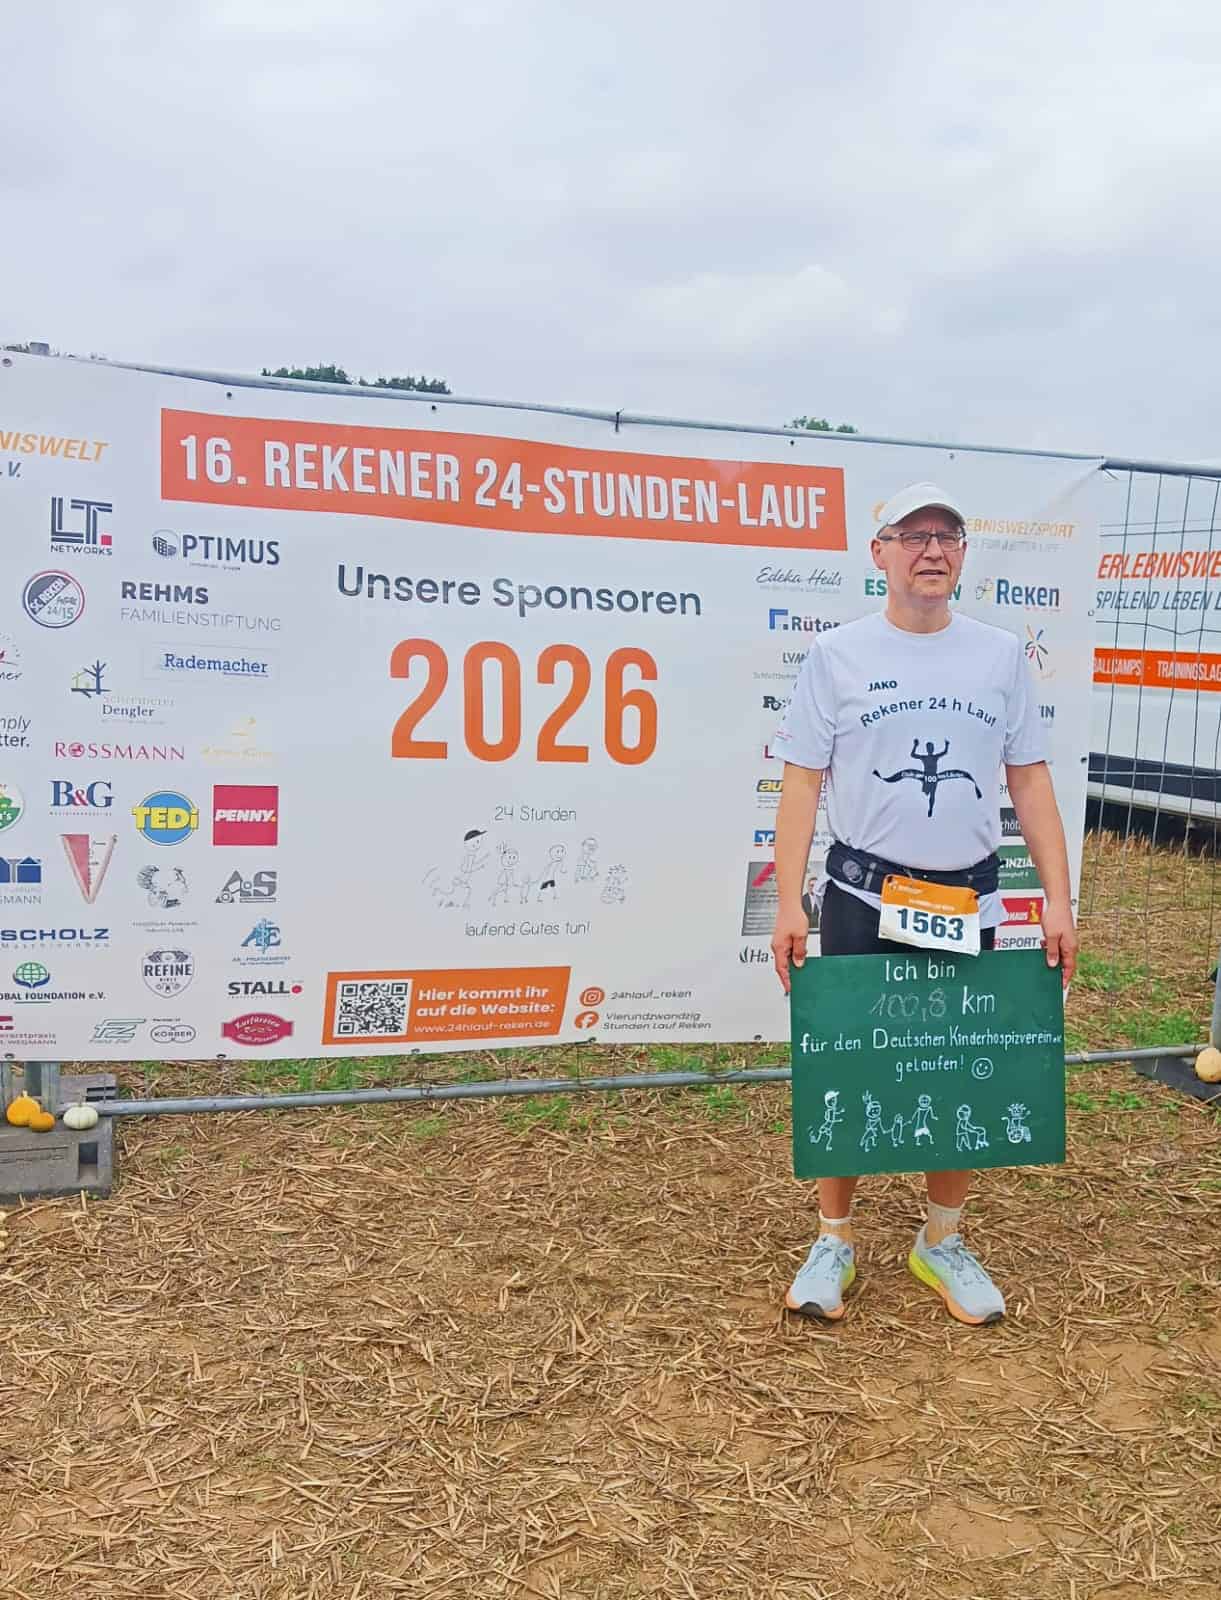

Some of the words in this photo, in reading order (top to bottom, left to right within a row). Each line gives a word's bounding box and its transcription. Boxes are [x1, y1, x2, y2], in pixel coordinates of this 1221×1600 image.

[180, 435, 247, 486] 16.
[265, 440, 460, 502] REKENER
[474, 456, 827, 530] 24-STUNDEN-LAUF
[51, 544, 112, 556] NETWORKS
[756, 566, 801, 584] Edeka
[807, 567, 843, 586] Heils
[122, 581, 209, 604] REHMS
[337, 563, 482, 606] Unsere
[492, 577, 703, 618] Sponsoren
[996, 578, 1060, 607] Reken
[121, 606, 281, 633] FAMILIENSTIFTUNG
[165, 653, 268, 673] Rademacher
[867, 680, 898, 692] JAKO
[103, 703, 155, 719] Dengler
[389, 637, 659, 766] 2026
[861, 699, 925, 727] Rekener
[929, 697, 947, 710] 24
[952, 698, 962, 711] h
[55, 741, 185, 761] ROSSMANN
[50, 780, 115, 808] B&G
[494, 805, 514, 821] 24
[519, 805, 577, 822] Stunden
[1, 928, 110, 941] SCHOLZ
[464, 920, 516, 938] laufend
[519, 920, 561, 937] Gutes
[896, 908, 965, 942] 1563
[144, 964, 193, 978] REFINE
[885, 959, 919, 982] Ich
[927, 956, 957, 980] bin
[25, 991, 85, 1001] FOUNDATION
[88, 991, 107, 1001] e.V.
[228, 981, 290, 996] STALL
[418, 987, 455, 1001] Hier
[458, 985, 521, 1001] kommt
[526, 984, 549, 999] ihr
[416, 1003, 448, 1018] auf
[450, 1002, 477, 1016] die
[480, 1001, 557, 1015] Website:
[961, 984, 997, 1016] km
[414, 1019, 552, 1033] www.24hlauf-reken.de
[603, 1021, 651, 1031] Stunden
[653, 1020, 678, 1030] Lauf
[678, 1020, 713, 1030] Reken
[799, 1032, 828, 1053] für
[834, 1032, 864, 1051] den
[872, 1027, 947, 1050] Deutschen
[949, 1023, 1052, 1052] Kinderhospizverein
[895, 1054, 966, 1083] gelaufen!
